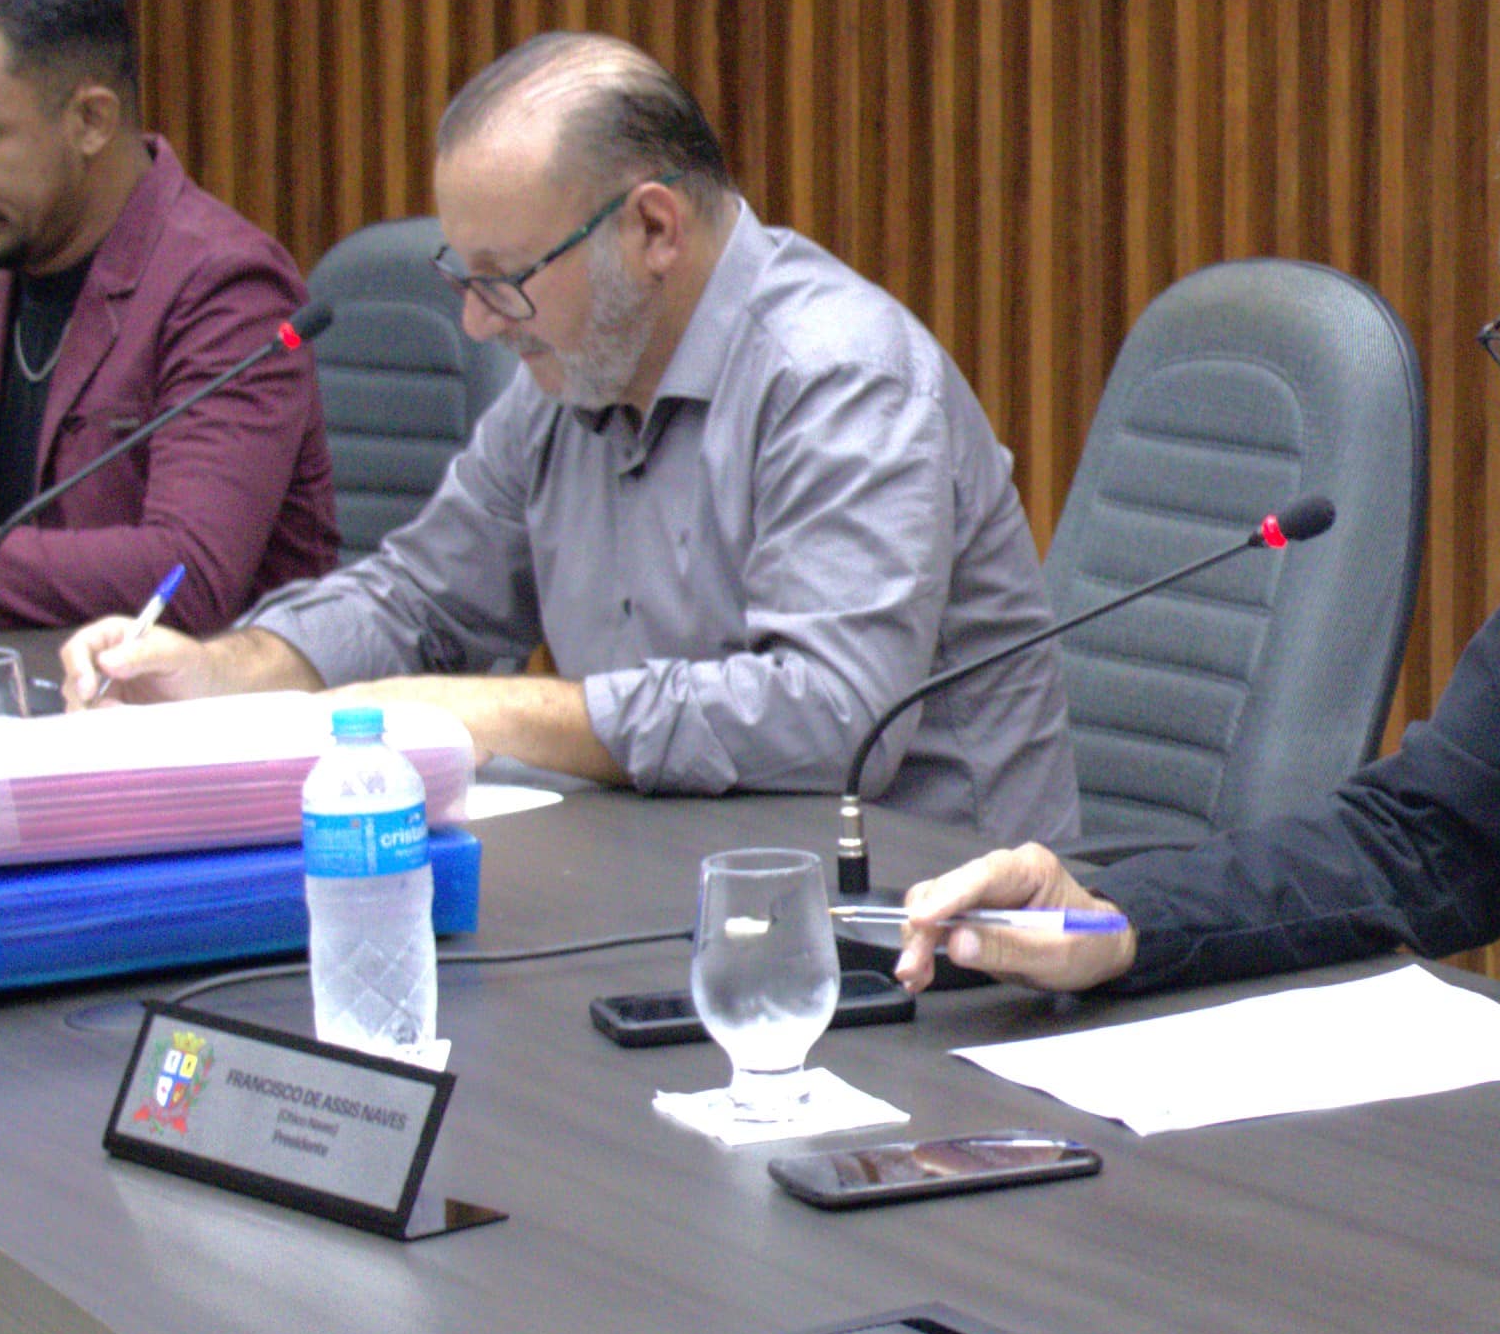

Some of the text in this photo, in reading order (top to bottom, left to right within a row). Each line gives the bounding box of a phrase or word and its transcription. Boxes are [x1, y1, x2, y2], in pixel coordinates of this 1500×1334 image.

[225, 1069, 407, 1131] FRANCISCO DE ASSIS NAVES
